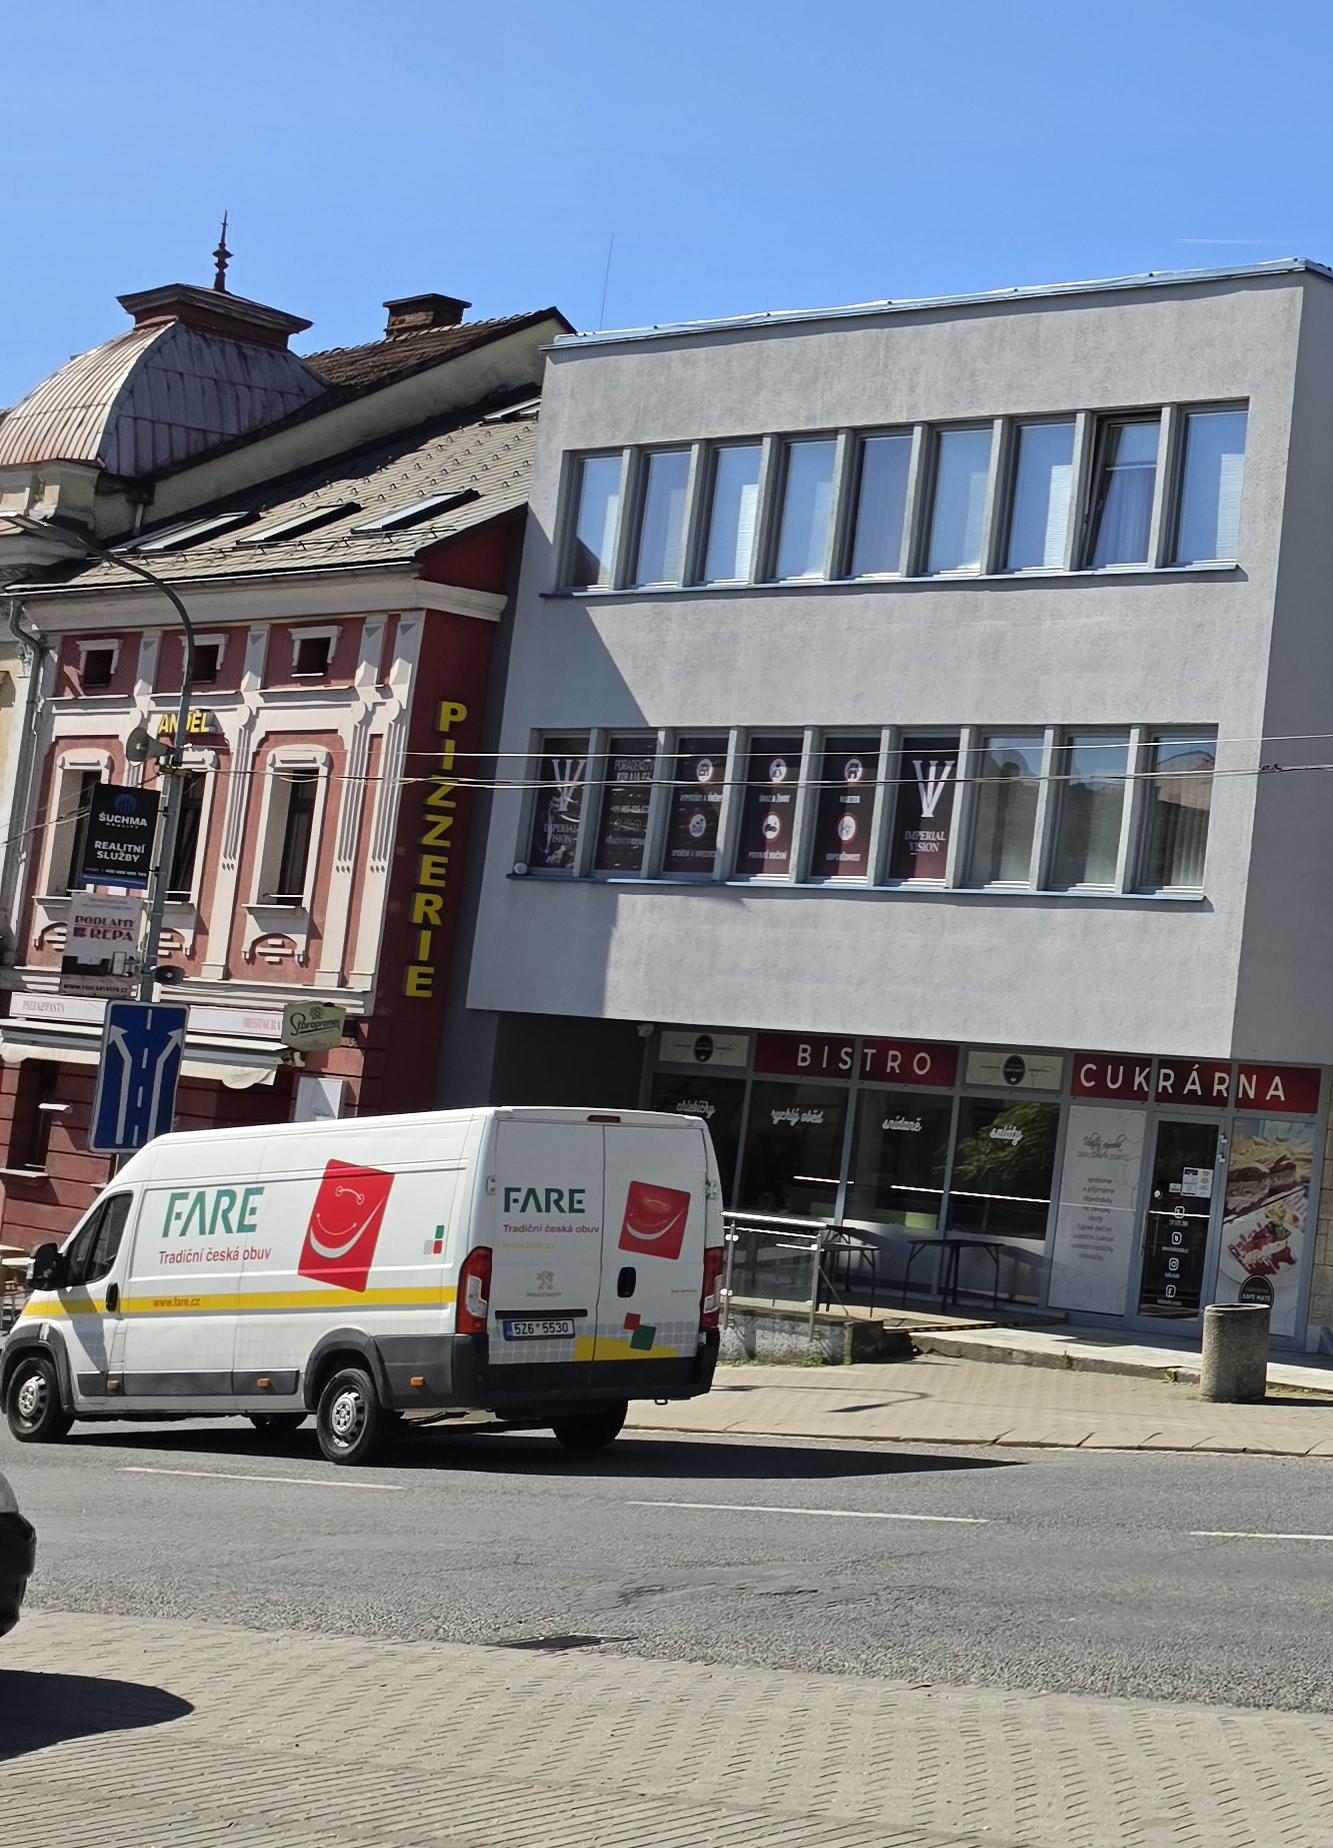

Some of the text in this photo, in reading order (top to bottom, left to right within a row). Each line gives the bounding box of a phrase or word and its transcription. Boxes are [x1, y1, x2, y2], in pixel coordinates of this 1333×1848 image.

[98, 811, 148, 827] ŠUCHMA
[904, 830, 947, 842] IMPERIAL
[94, 840, 146, 854] REALITNÍ
[404, 701, 467, 998] PIZZERIE
[96, 850, 140, 863] SLUŽBY
[797, 1043, 932, 1076] BISTRO
[1080, 1063, 1286, 1101] CUKRÁRNA
[504, 1187, 586, 1213] FARE
[162, 1187, 265, 1238] FARE
[504, 1223, 600, 1234] Tradiční česká obuv
[159, 1245, 272, 1265] Tradiční česká obuv
[514, 1321, 568, 1334] 5Z6 5530
